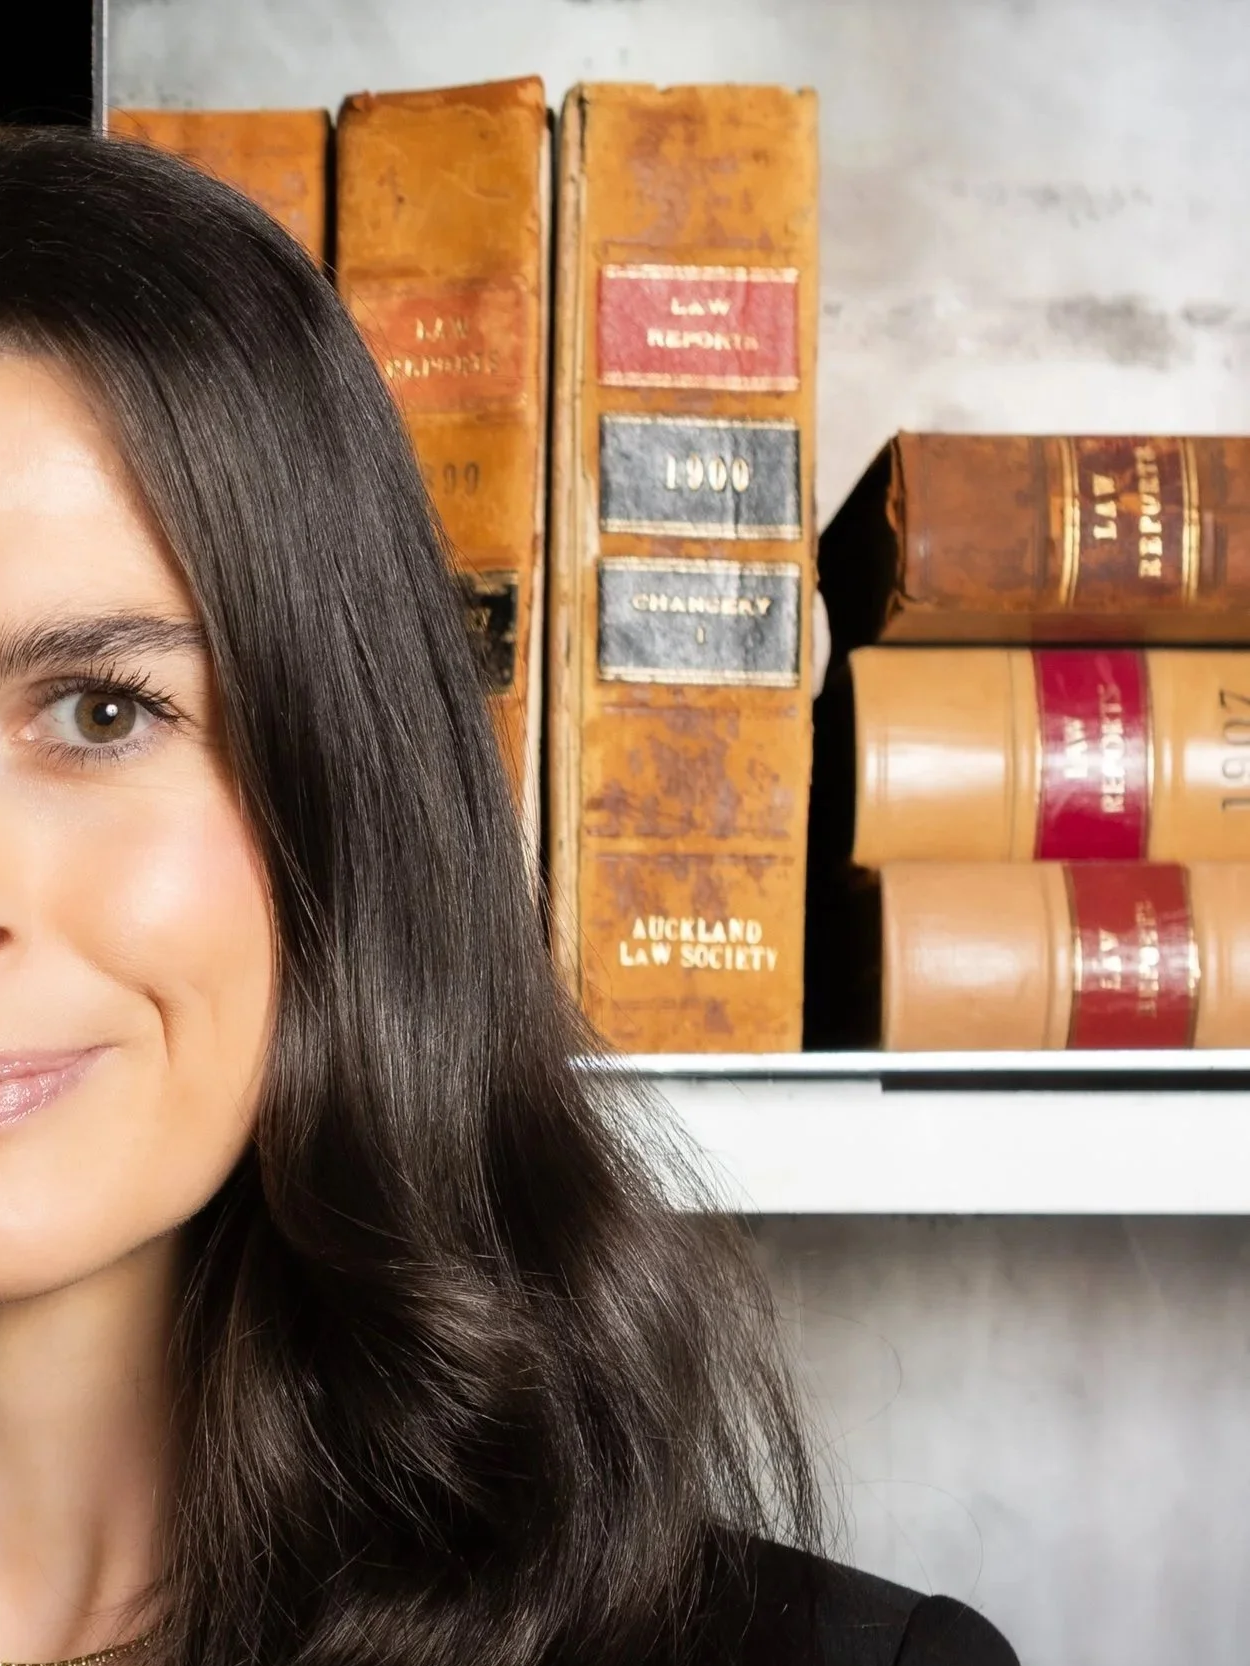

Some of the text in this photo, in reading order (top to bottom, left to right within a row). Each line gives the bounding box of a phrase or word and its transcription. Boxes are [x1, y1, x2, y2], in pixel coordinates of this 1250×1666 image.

[671, 298, 732, 316] LAW
[647, 328, 760, 351] REPORTS
[665, 453, 750, 491] 1900
[1092, 473, 1118, 541] LAW
[631, 593, 772, 617] CHANCERY
[1064, 716, 1089, 779] LAW
[632, 917, 763, 944] AUCKLAND
[620, 941, 779, 971] LAW SOCIETY
